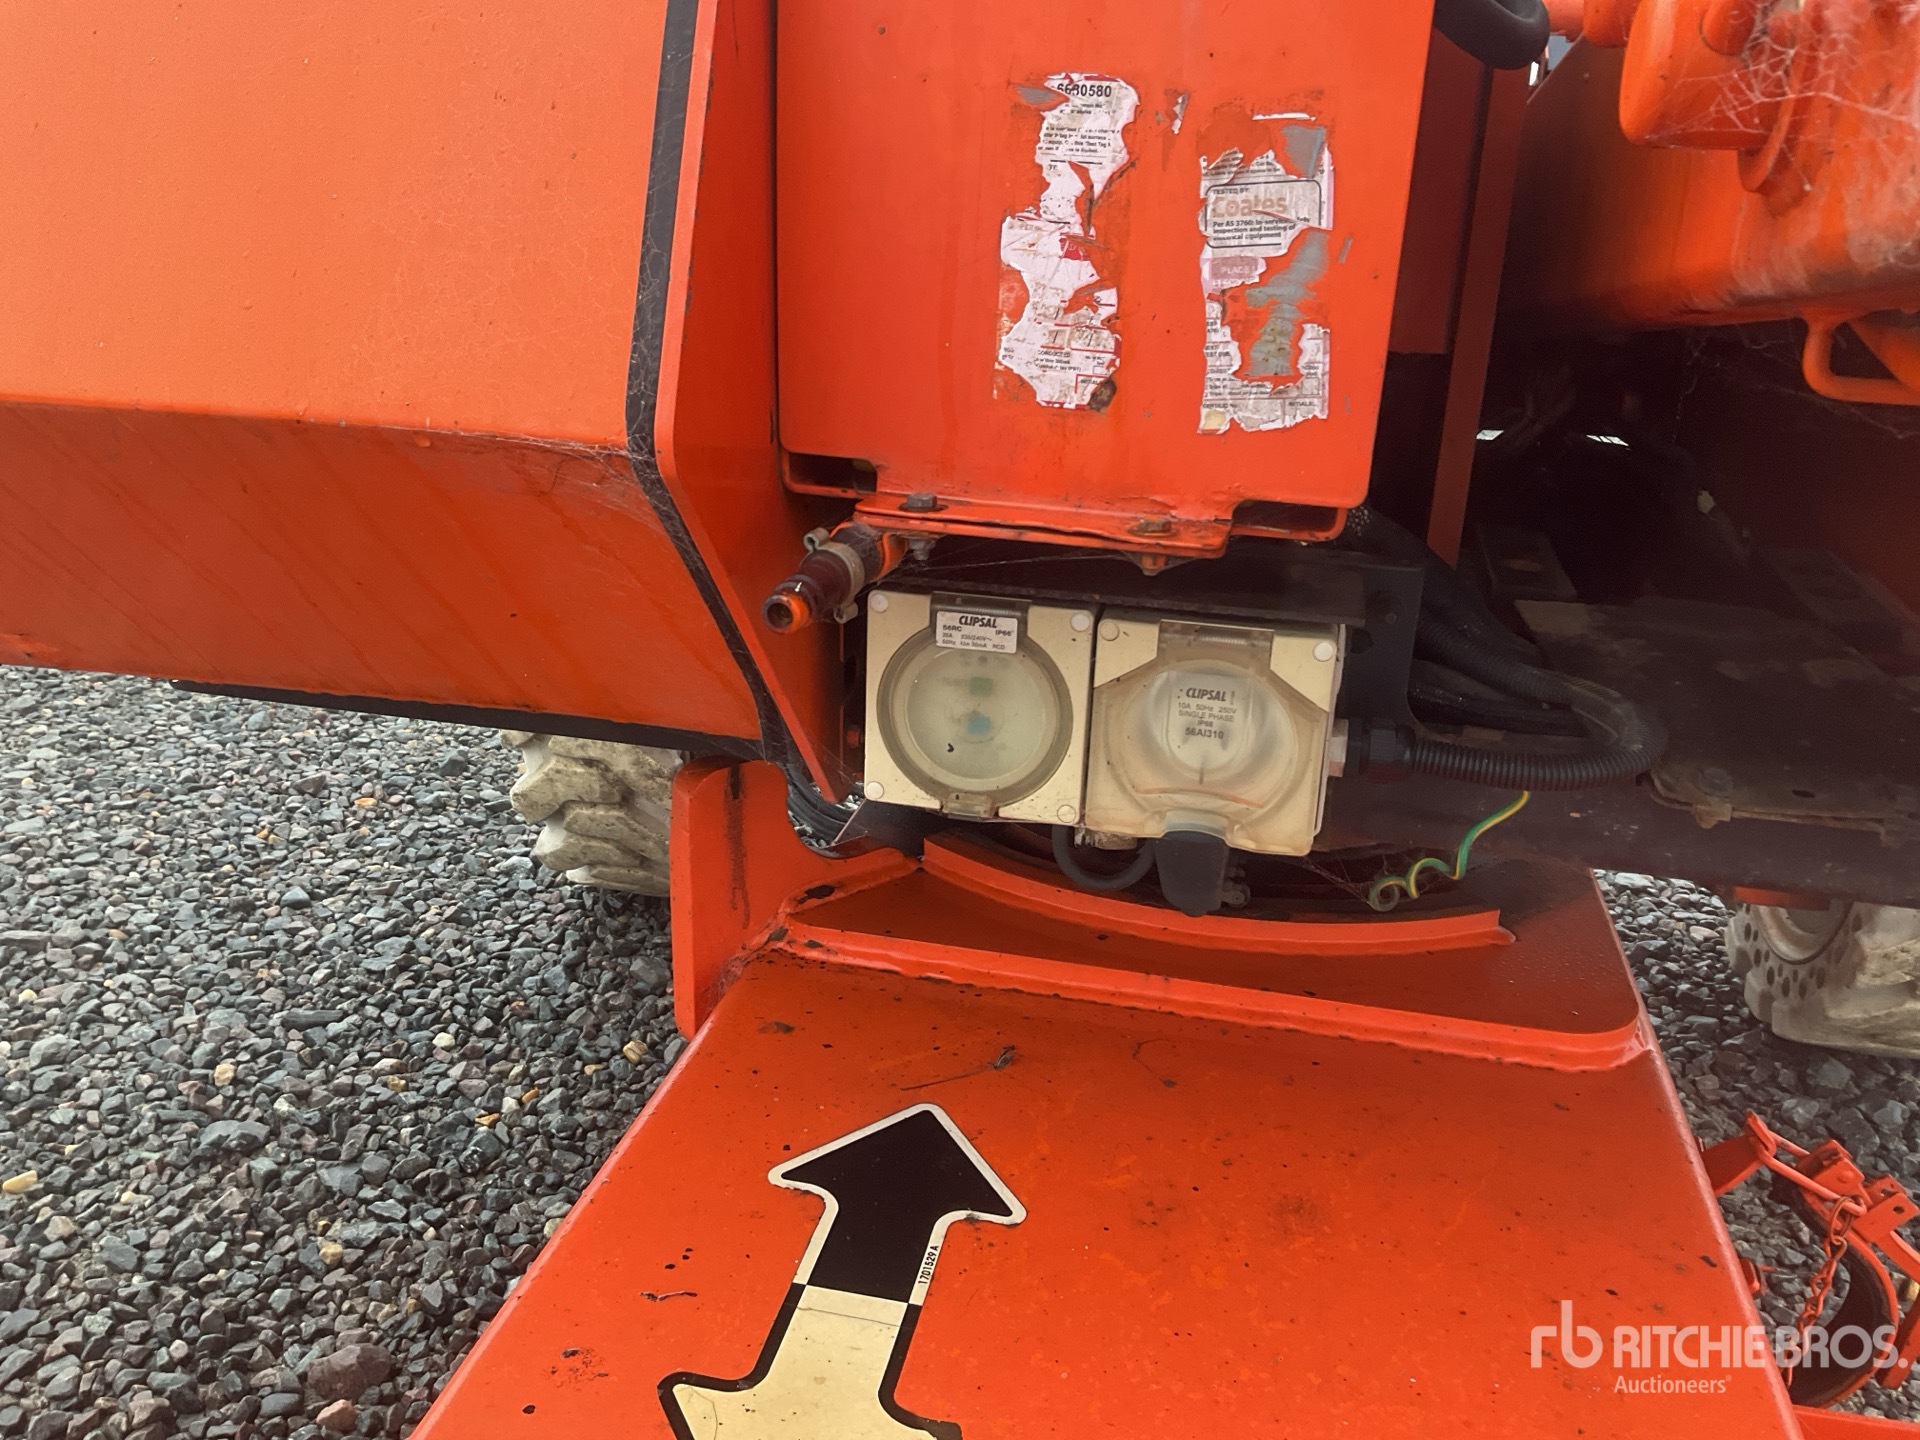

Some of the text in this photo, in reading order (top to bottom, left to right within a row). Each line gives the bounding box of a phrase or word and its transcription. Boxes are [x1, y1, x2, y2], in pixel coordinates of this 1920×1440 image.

[959, 615, 998, 628] CLIPSAL
[1186, 687, 1227, 702] CLIPSAL
[1195, 704, 1214, 712] 50Hz
[1218, 706, 1237, 714] 250V
[1178, 710, 1235, 722] SINGLE PHASE
